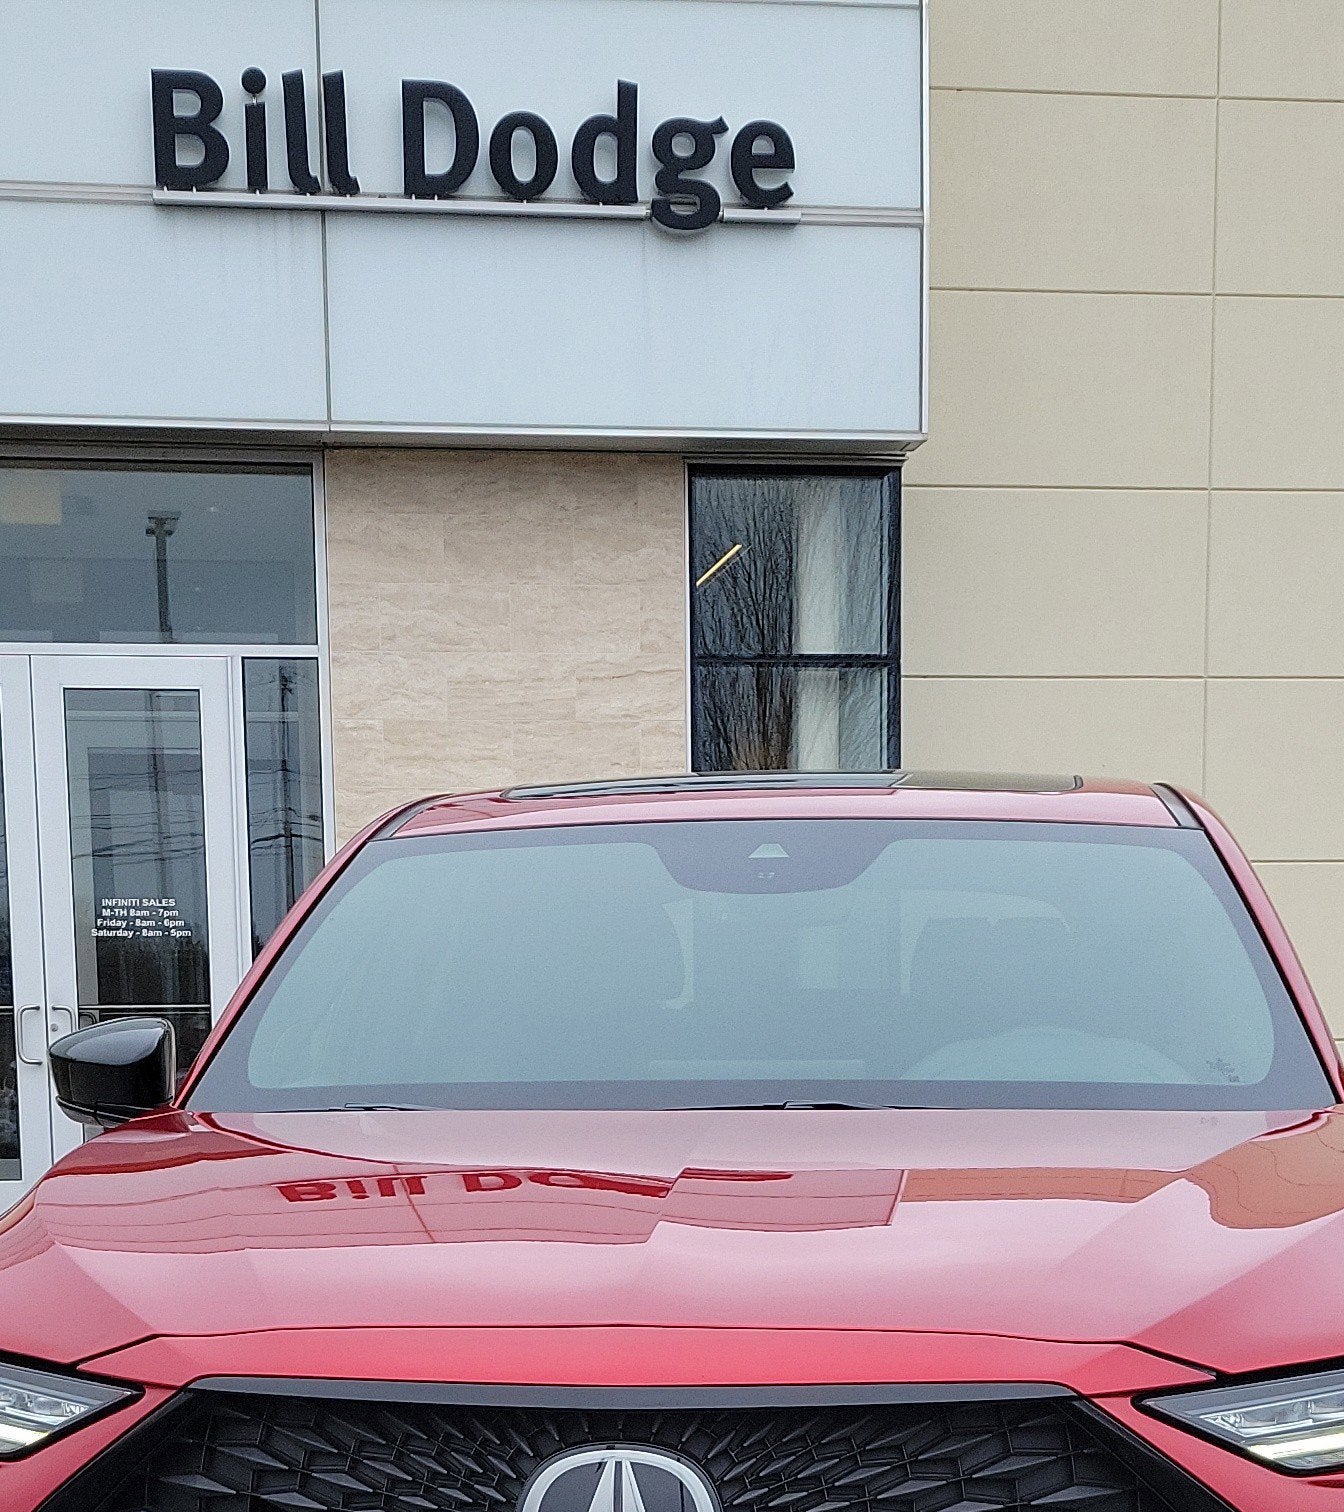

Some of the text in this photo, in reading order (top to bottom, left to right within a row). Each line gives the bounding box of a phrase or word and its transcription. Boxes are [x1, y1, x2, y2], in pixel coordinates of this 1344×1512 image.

[151, 67, 796, 230] Bill Dodge
[101, 898, 176, 907] INFINITI SALES
[102, 908, 128, 917] M-TH
[129, 908, 150, 917] 8am
[158, 908, 179, 918] 7pm
[97, 918, 128, 928] Friday
[135, 918, 156, 927] 8am
[91, 928, 134, 938] Saturday
[170, 928, 192, 938] 5pm
